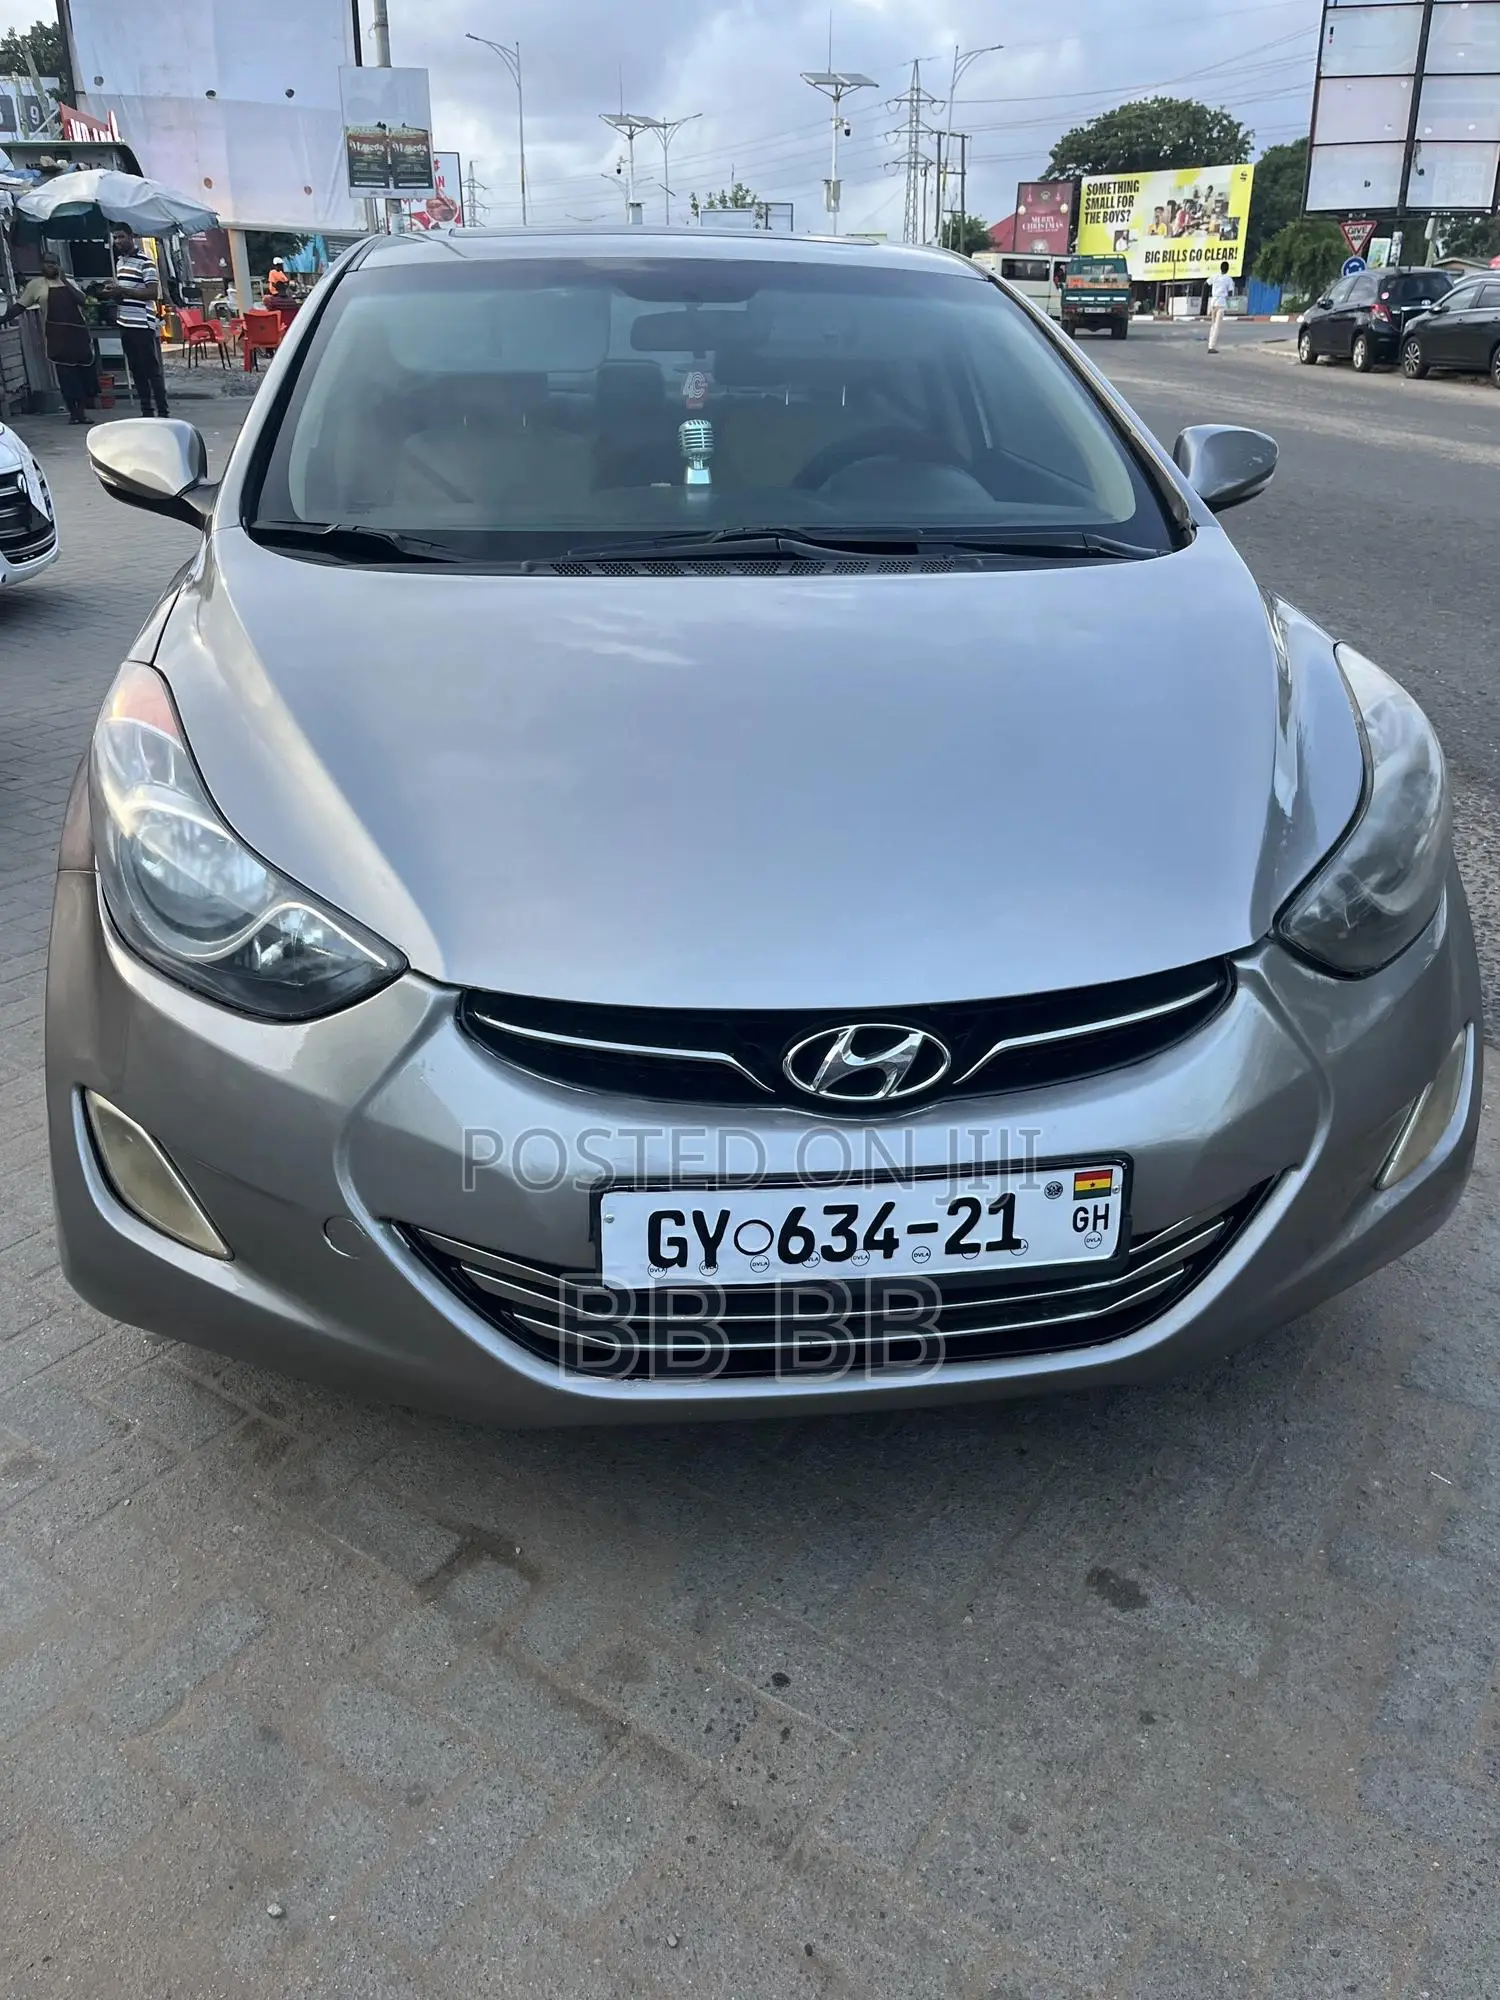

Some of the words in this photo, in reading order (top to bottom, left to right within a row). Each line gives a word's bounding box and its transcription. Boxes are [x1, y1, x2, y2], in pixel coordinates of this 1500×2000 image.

[1086, 180, 1140, 196] SOMETHING
[1085, 196, 1115, 211] SMALL
[1116, 195, 1135, 208] FOR
[1084, 211, 1104, 225] THE
[1103, 209, 1131, 224] BOYS?
[1348, 225, 1368, 235] GIVE
[1145, 251, 1160, 264] BIG
[1162, 249, 1188, 263] BILLS
[1189, 248, 1202, 262] GO
[1204, 247, 1239, 261] CLEAR!
[1072, 1203, 1110, 1233] GH
[647, 1209, 731, 1269] GY
[777, 1192, 1023, 1266] 634-21
